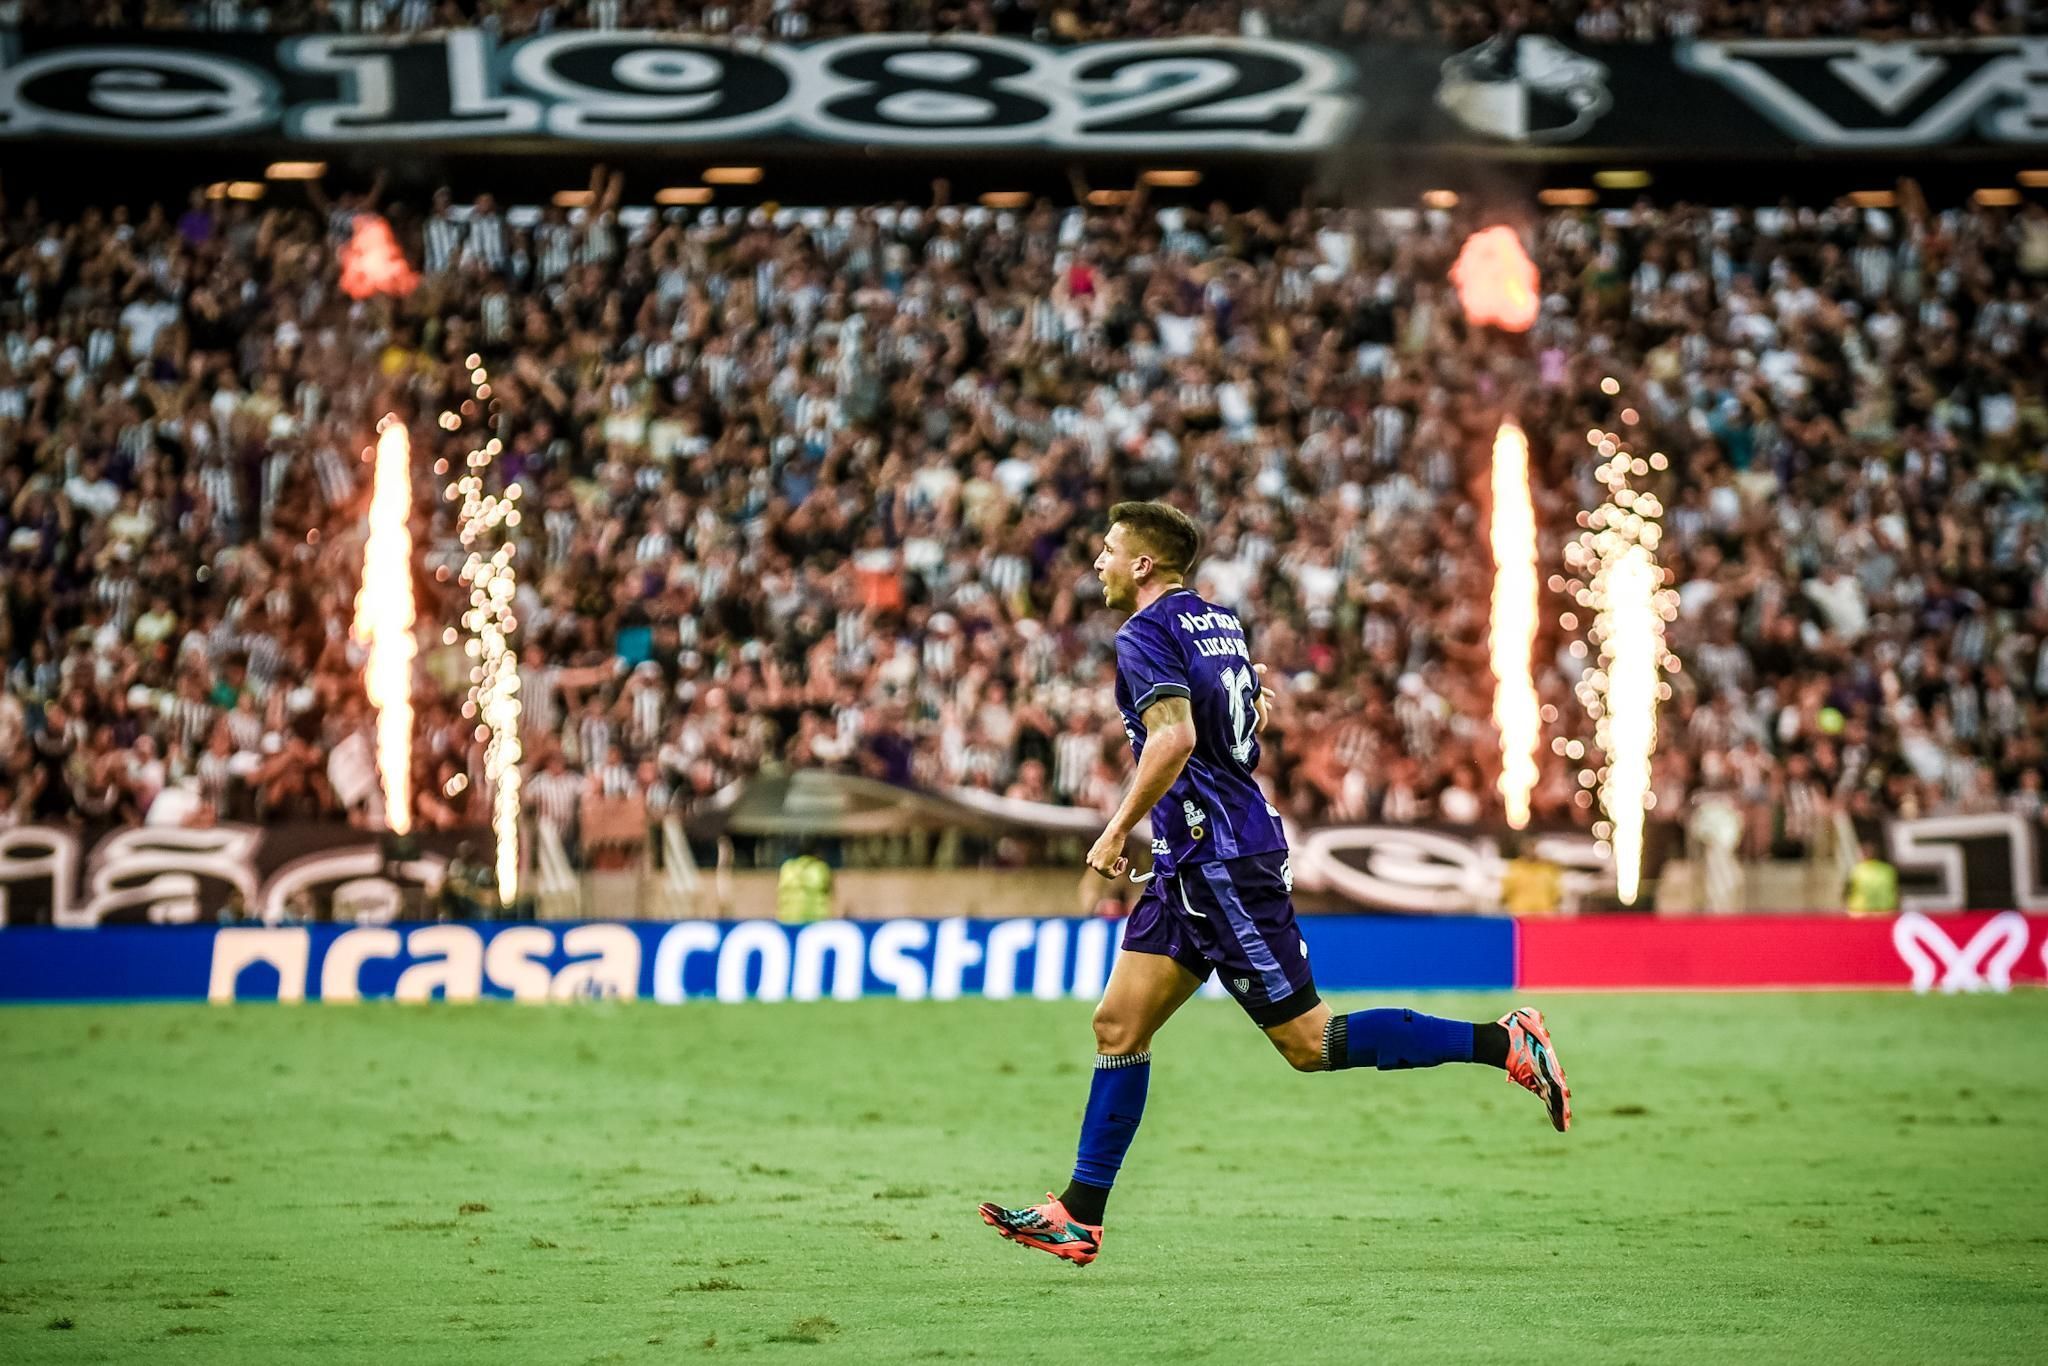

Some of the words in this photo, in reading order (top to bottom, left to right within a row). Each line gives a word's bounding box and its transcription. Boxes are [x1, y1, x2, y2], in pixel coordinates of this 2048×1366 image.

[283, 30, 1350, 149] 1982
[1193, 636, 1236, 657] LUCAS
[321, 923, 642, 1004] casa
[653, 918, 1130, 1004] constru
